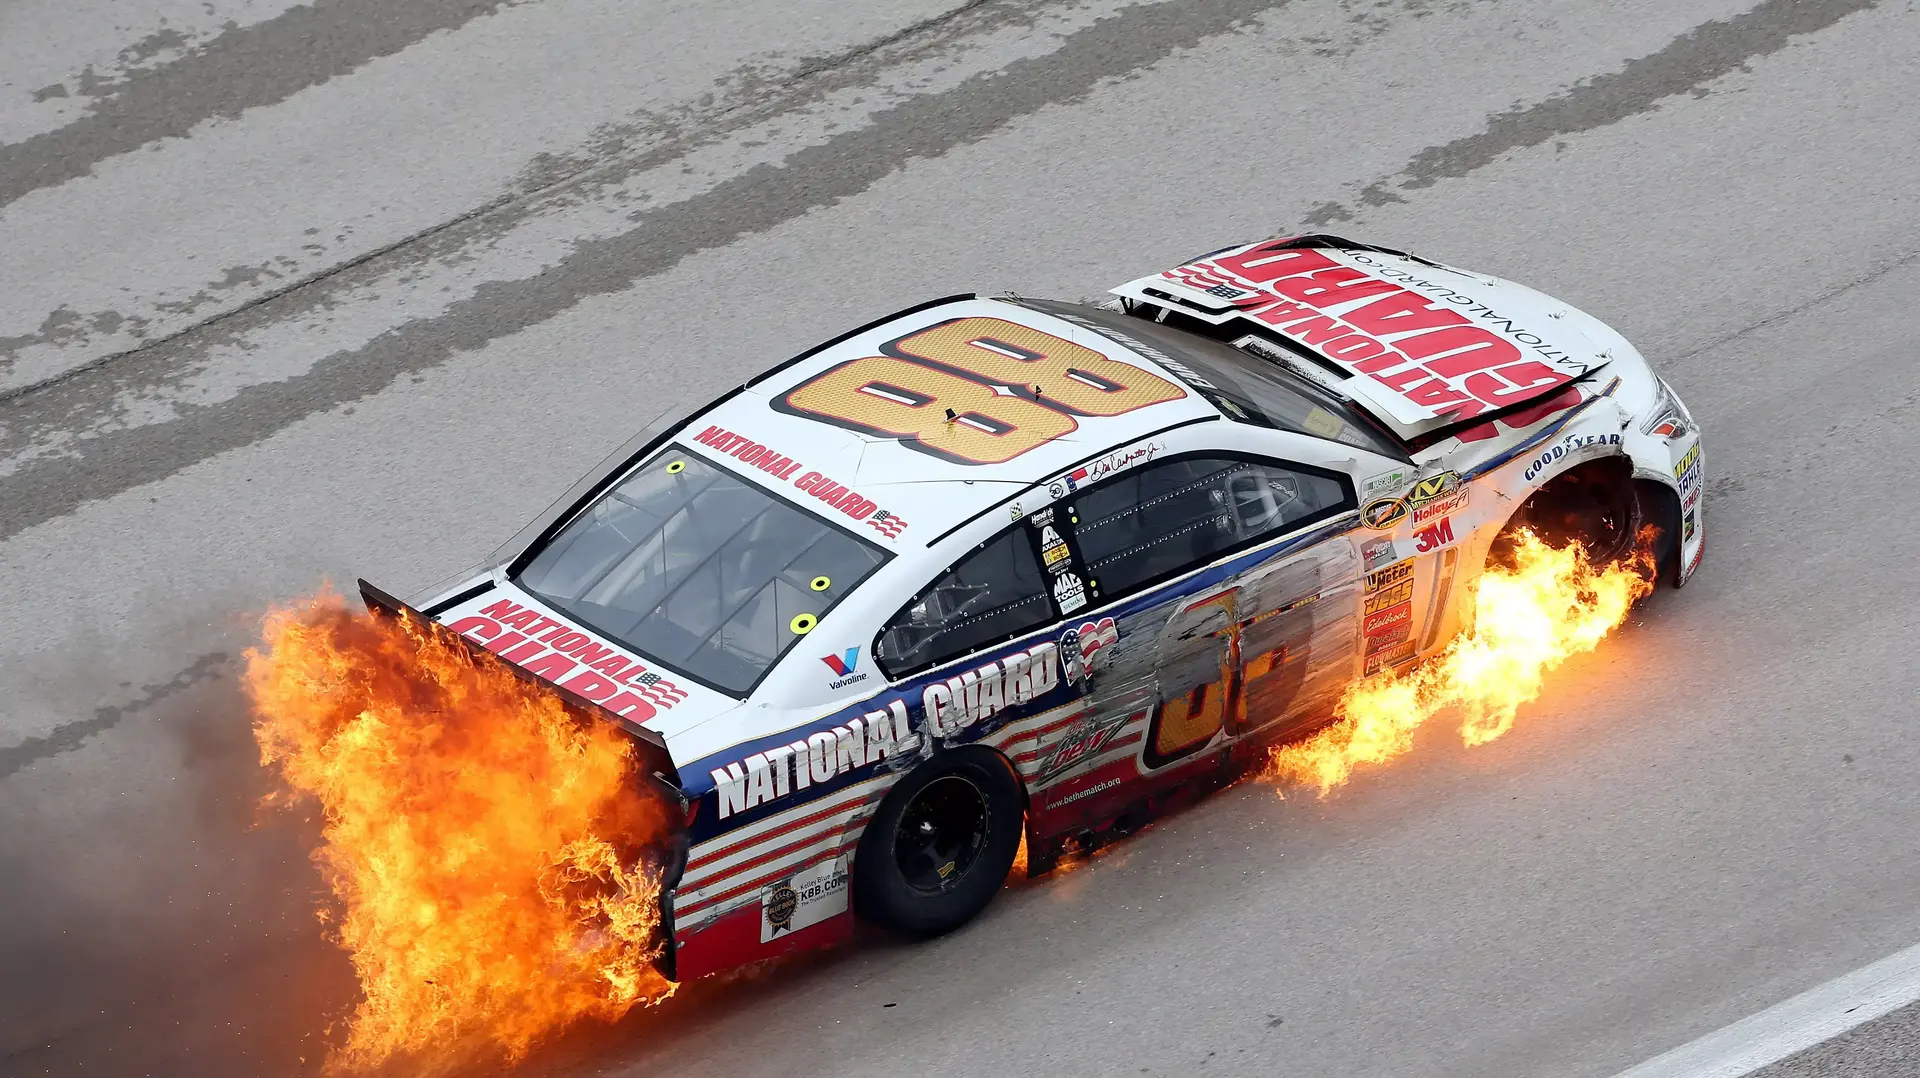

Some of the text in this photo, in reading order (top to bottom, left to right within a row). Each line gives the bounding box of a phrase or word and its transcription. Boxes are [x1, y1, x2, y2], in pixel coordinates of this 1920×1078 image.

[1212, 235, 1583, 429] GUARD
[1238, 293, 1499, 444] NATIONAL
[769, 316, 1188, 466] 88
[693, 425, 878, 521] NATIONAL GUARD
[1413, 500, 1449, 523] Holley
[1042, 538, 1065, 552] AXALTA
[1412, 515, 1455, 552] 3M
[1054, 572, 1082, 597] MAC
[1378, 564, 1413, 586] Meter
[1055, 585, 1085, 603] TOOLS
[1063, 596, 1084, 611] SIEMENS
[1365, 579, 1413, 614] JEGS
[1366, 607, 1408, 632] Edelbrock
[478, 599, 648, 686] NATIONAL
[828, 673, 868, 690] Valvoline
[709, 697, 920, 821] NATIONAL
[922, 641, 1062, 739] GUARD
[1046, 776, 1121, 811] www.bethematch.org
[800, 880, 817, 891] Kelley
[817, 873, 831, 883] Blue
